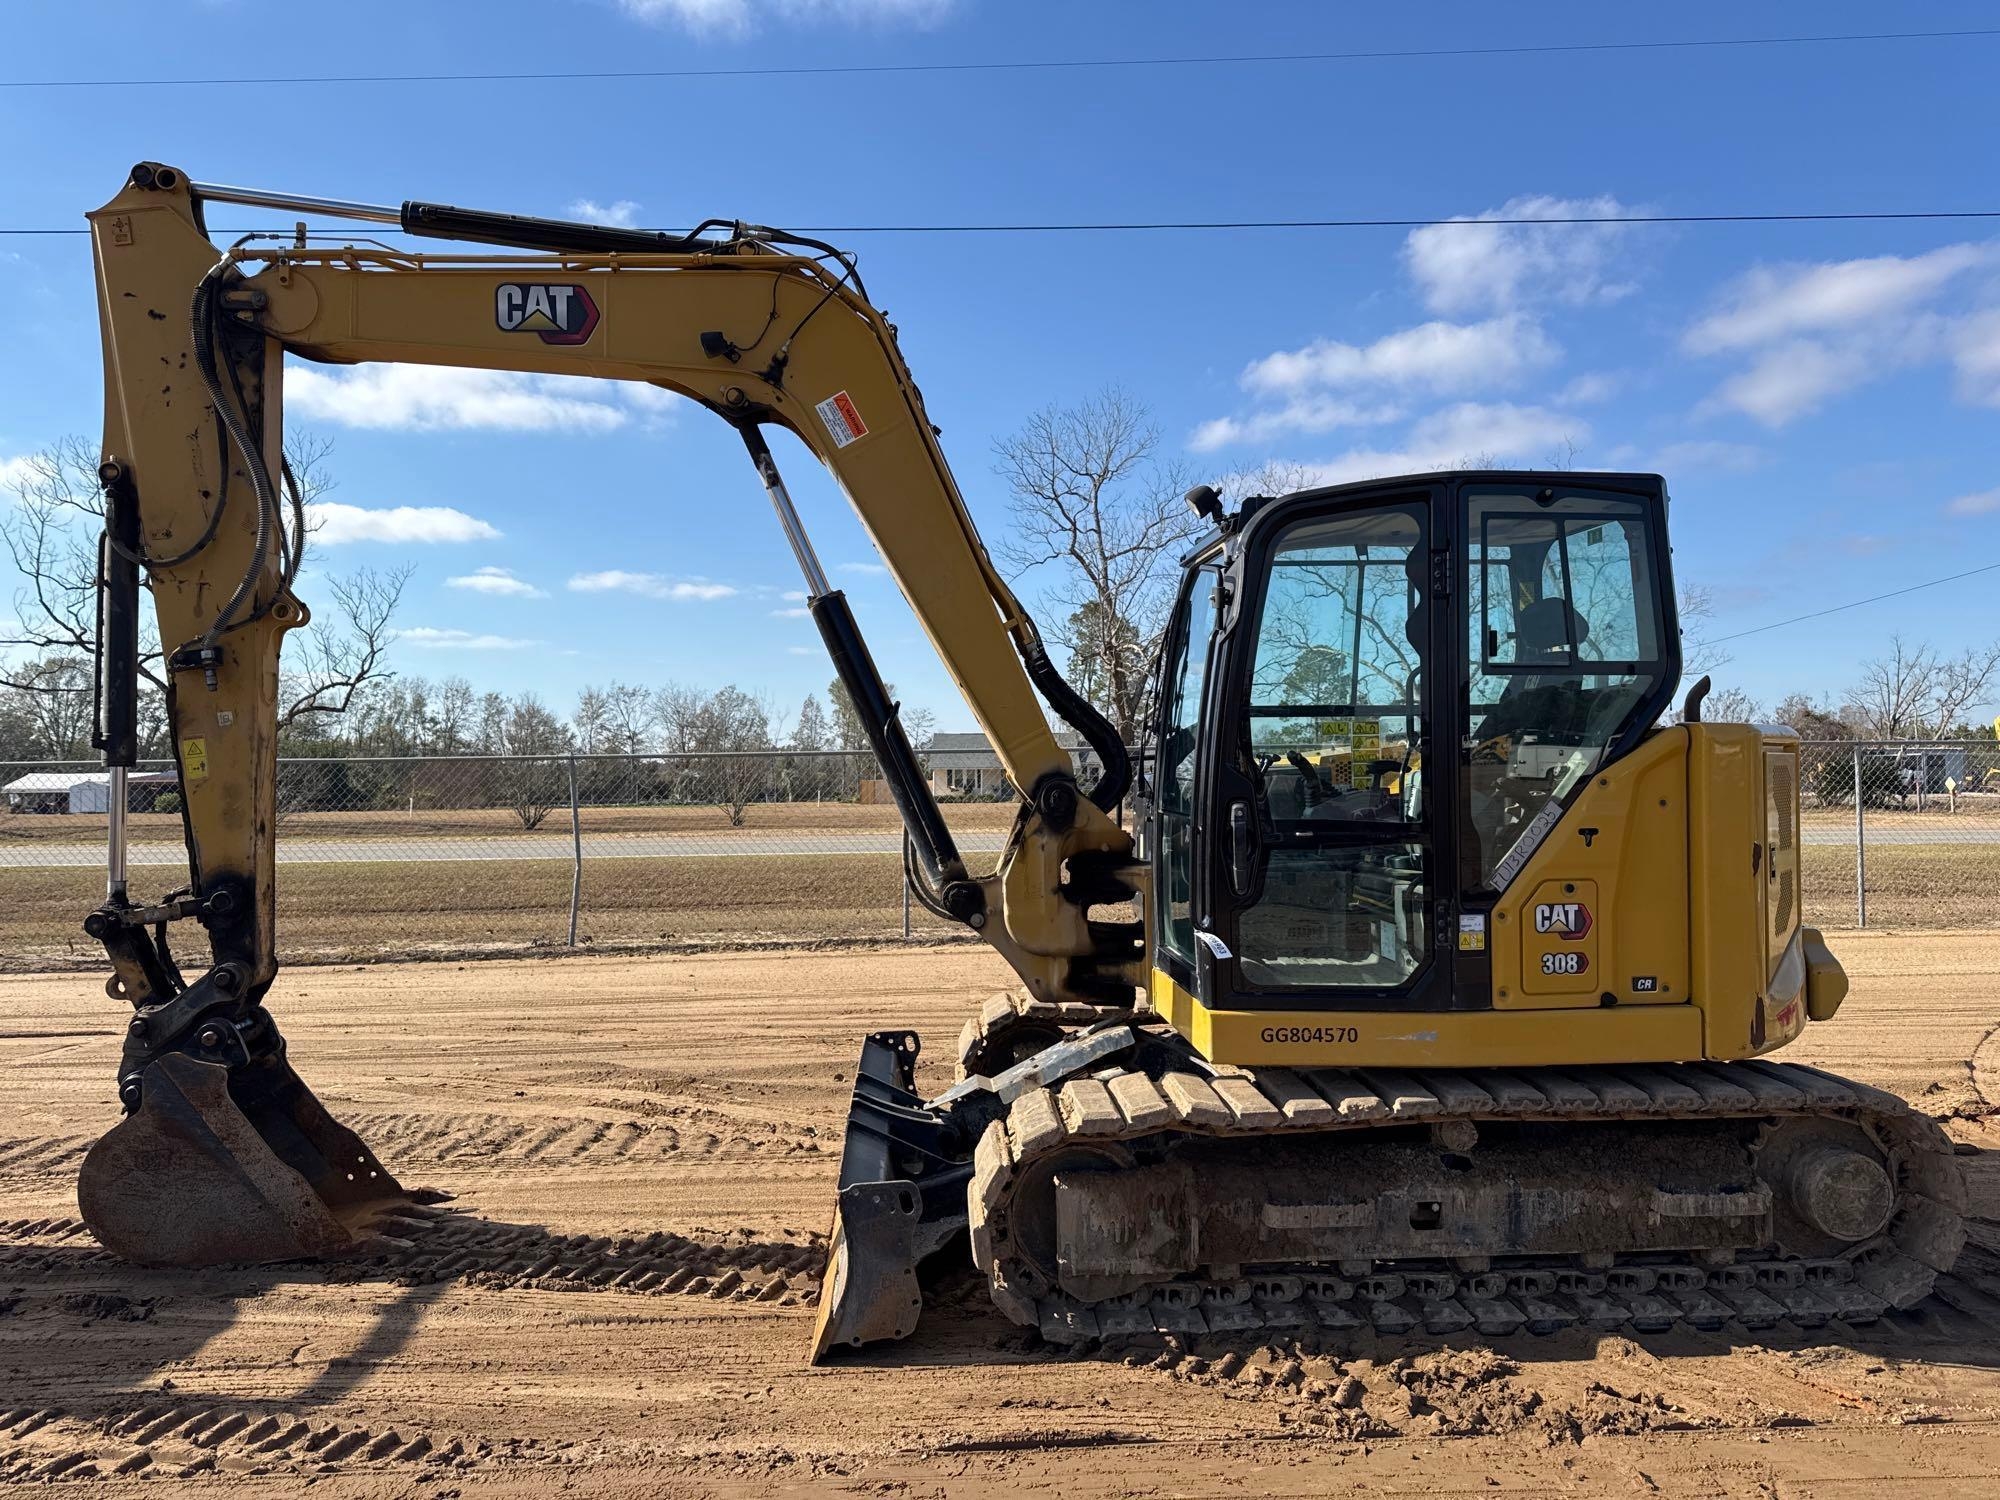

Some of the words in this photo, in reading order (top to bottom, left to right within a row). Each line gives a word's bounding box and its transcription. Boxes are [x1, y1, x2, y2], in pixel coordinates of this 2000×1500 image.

[497, 284, 574, 330] CAT
[1535, 904, 1579, 932] CAT
[1542, 953, 1578, 974] 308
[1637, 979, 1653, 990] CR
[1260, 1027, 1359, 1043] GG804570
